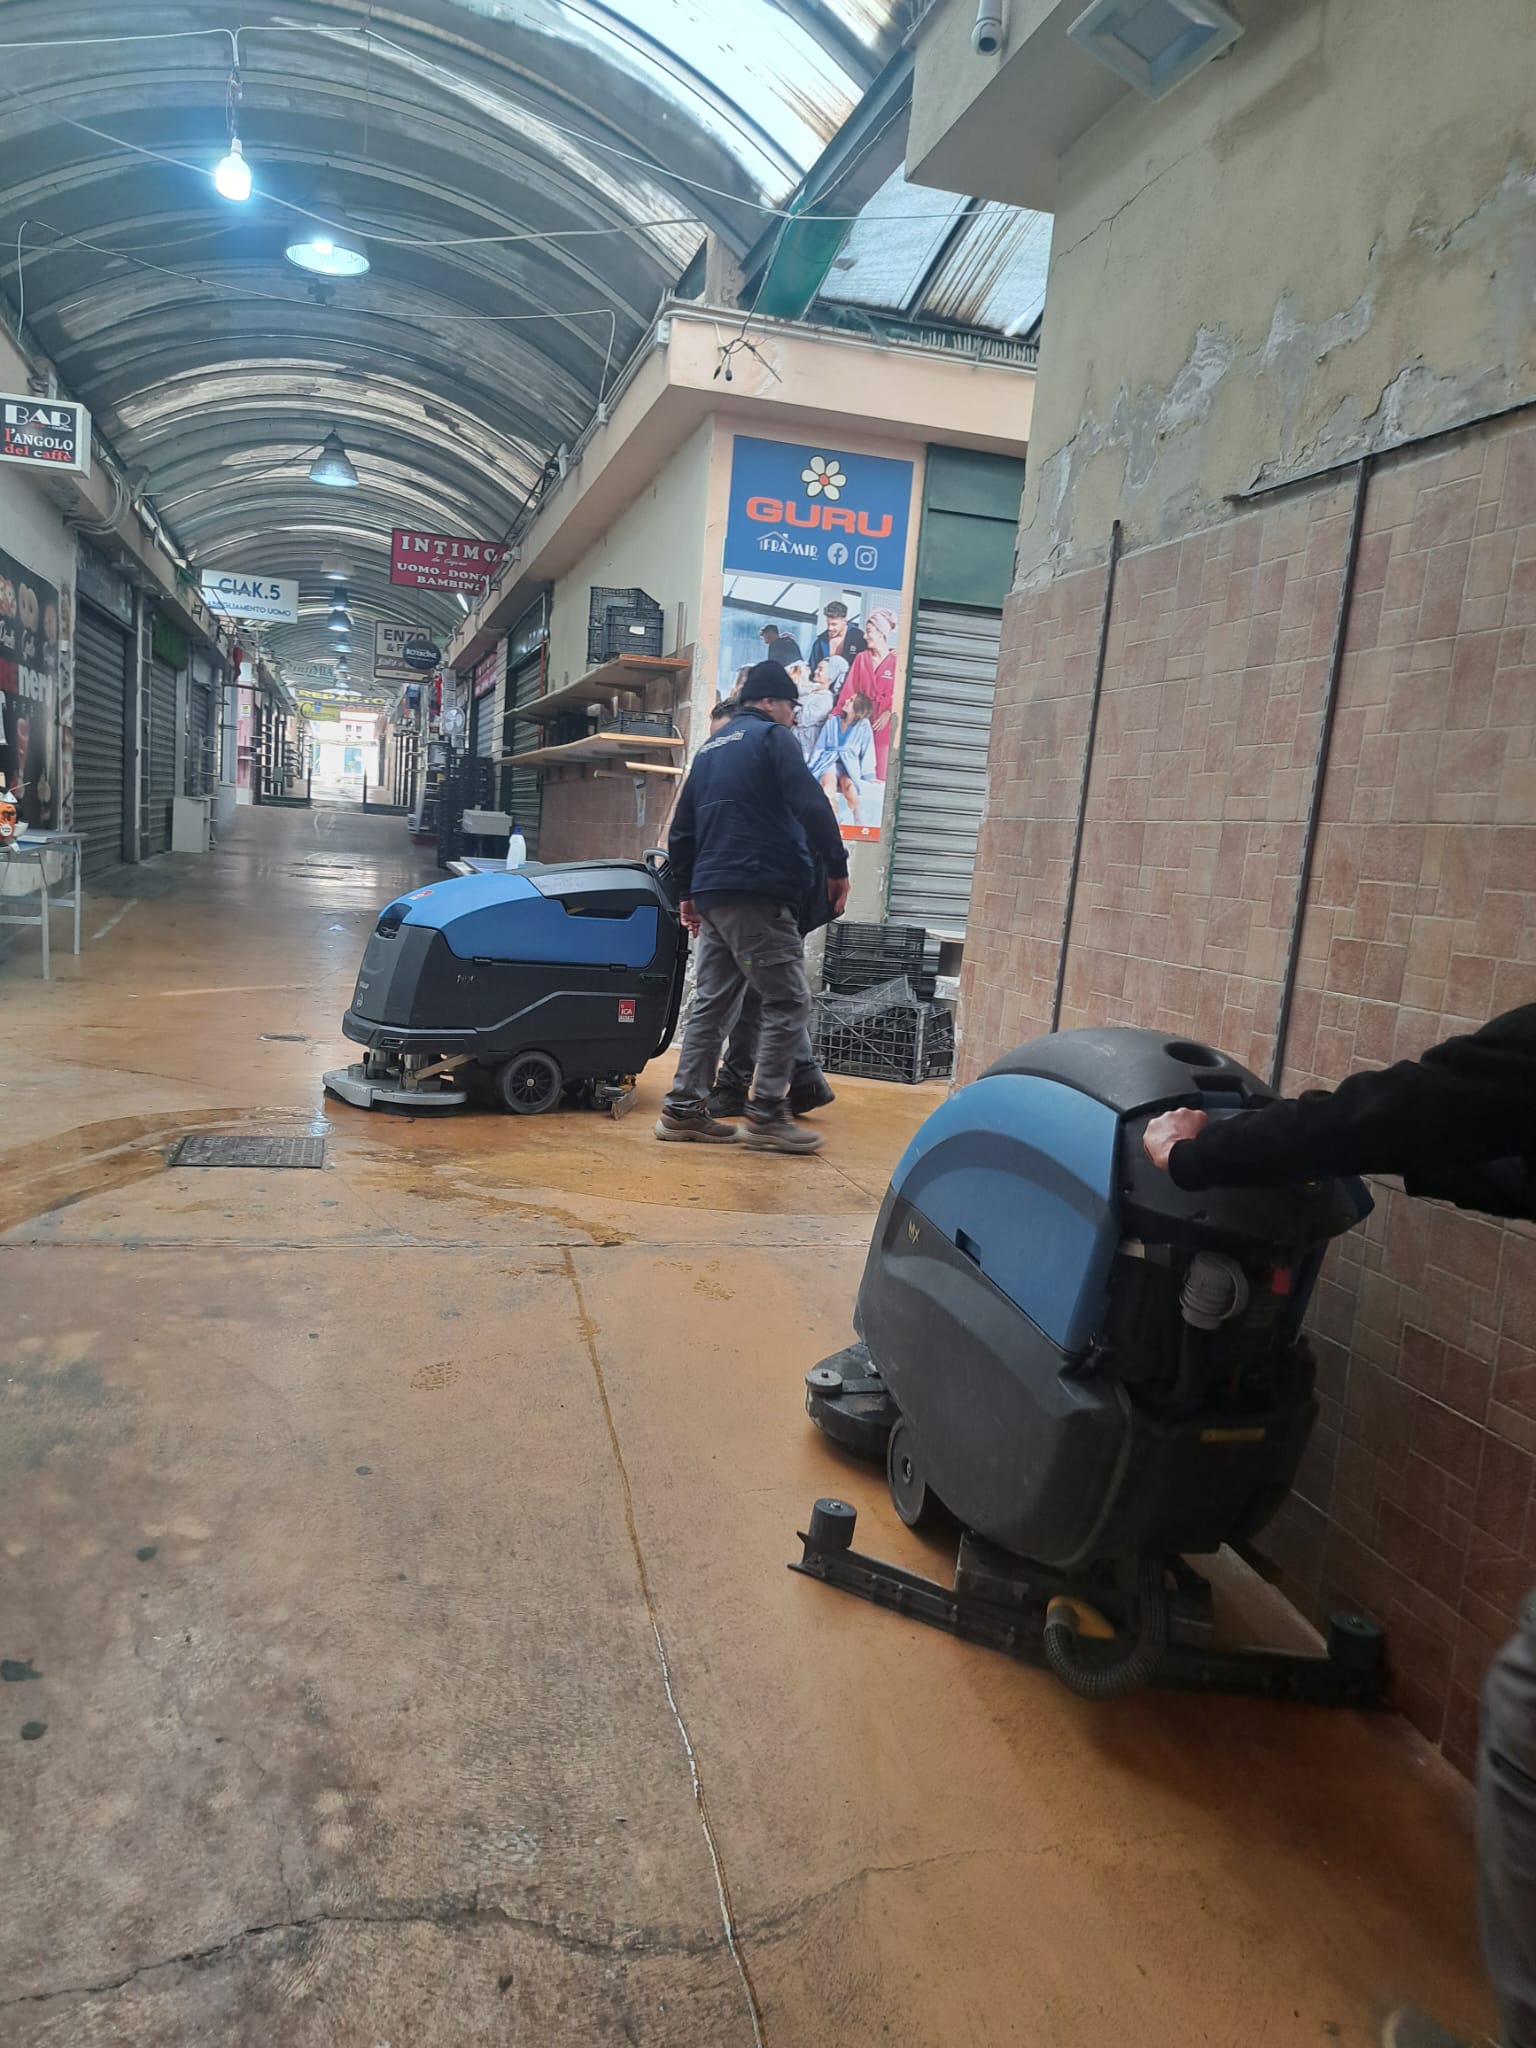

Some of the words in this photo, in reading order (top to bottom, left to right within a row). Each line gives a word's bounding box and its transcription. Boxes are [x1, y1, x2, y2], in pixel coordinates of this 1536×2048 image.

[5, 404, 71, 428] BAR
[5, 444, 29, 457] del
[33, 450, 72, 462] caffè
[746, 496, 893, 538] GURU
[401, 535, 497, 562] INTIMO
[397, 562, 439, 574] UOMO
[448, 569, 489, 582] DONN
[218, 578, 281, 601] CIAK.5
[267, 605, 292, 617] UOMO
